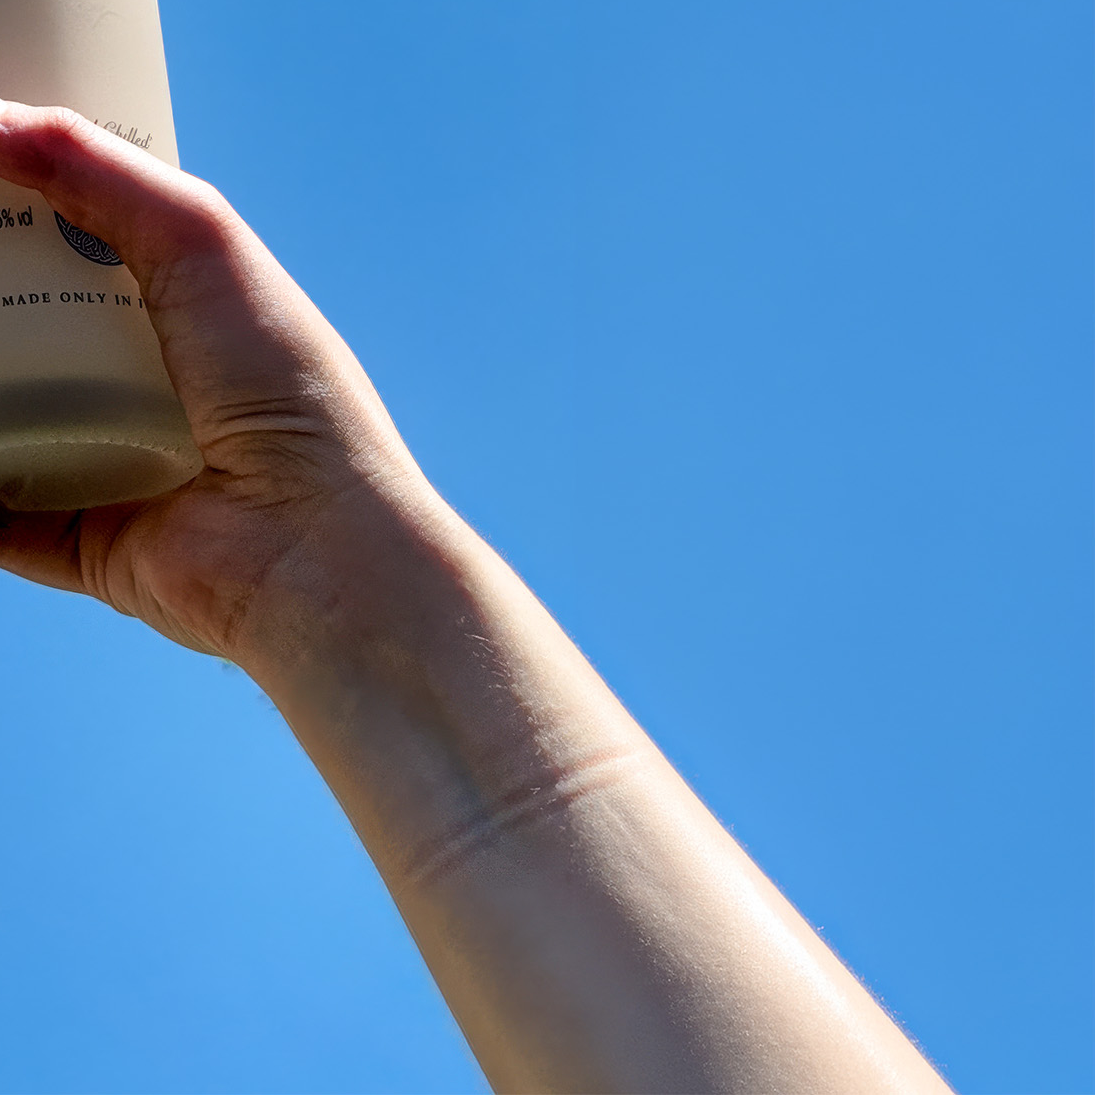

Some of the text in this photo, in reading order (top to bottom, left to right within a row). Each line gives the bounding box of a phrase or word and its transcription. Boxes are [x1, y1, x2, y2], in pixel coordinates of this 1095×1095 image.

[17, 205, 34, 227] vol
[2, 291, 51, 307] MADE
[59, 291, 107, 304] ONLY
[114, 293, 132, 307] IN
